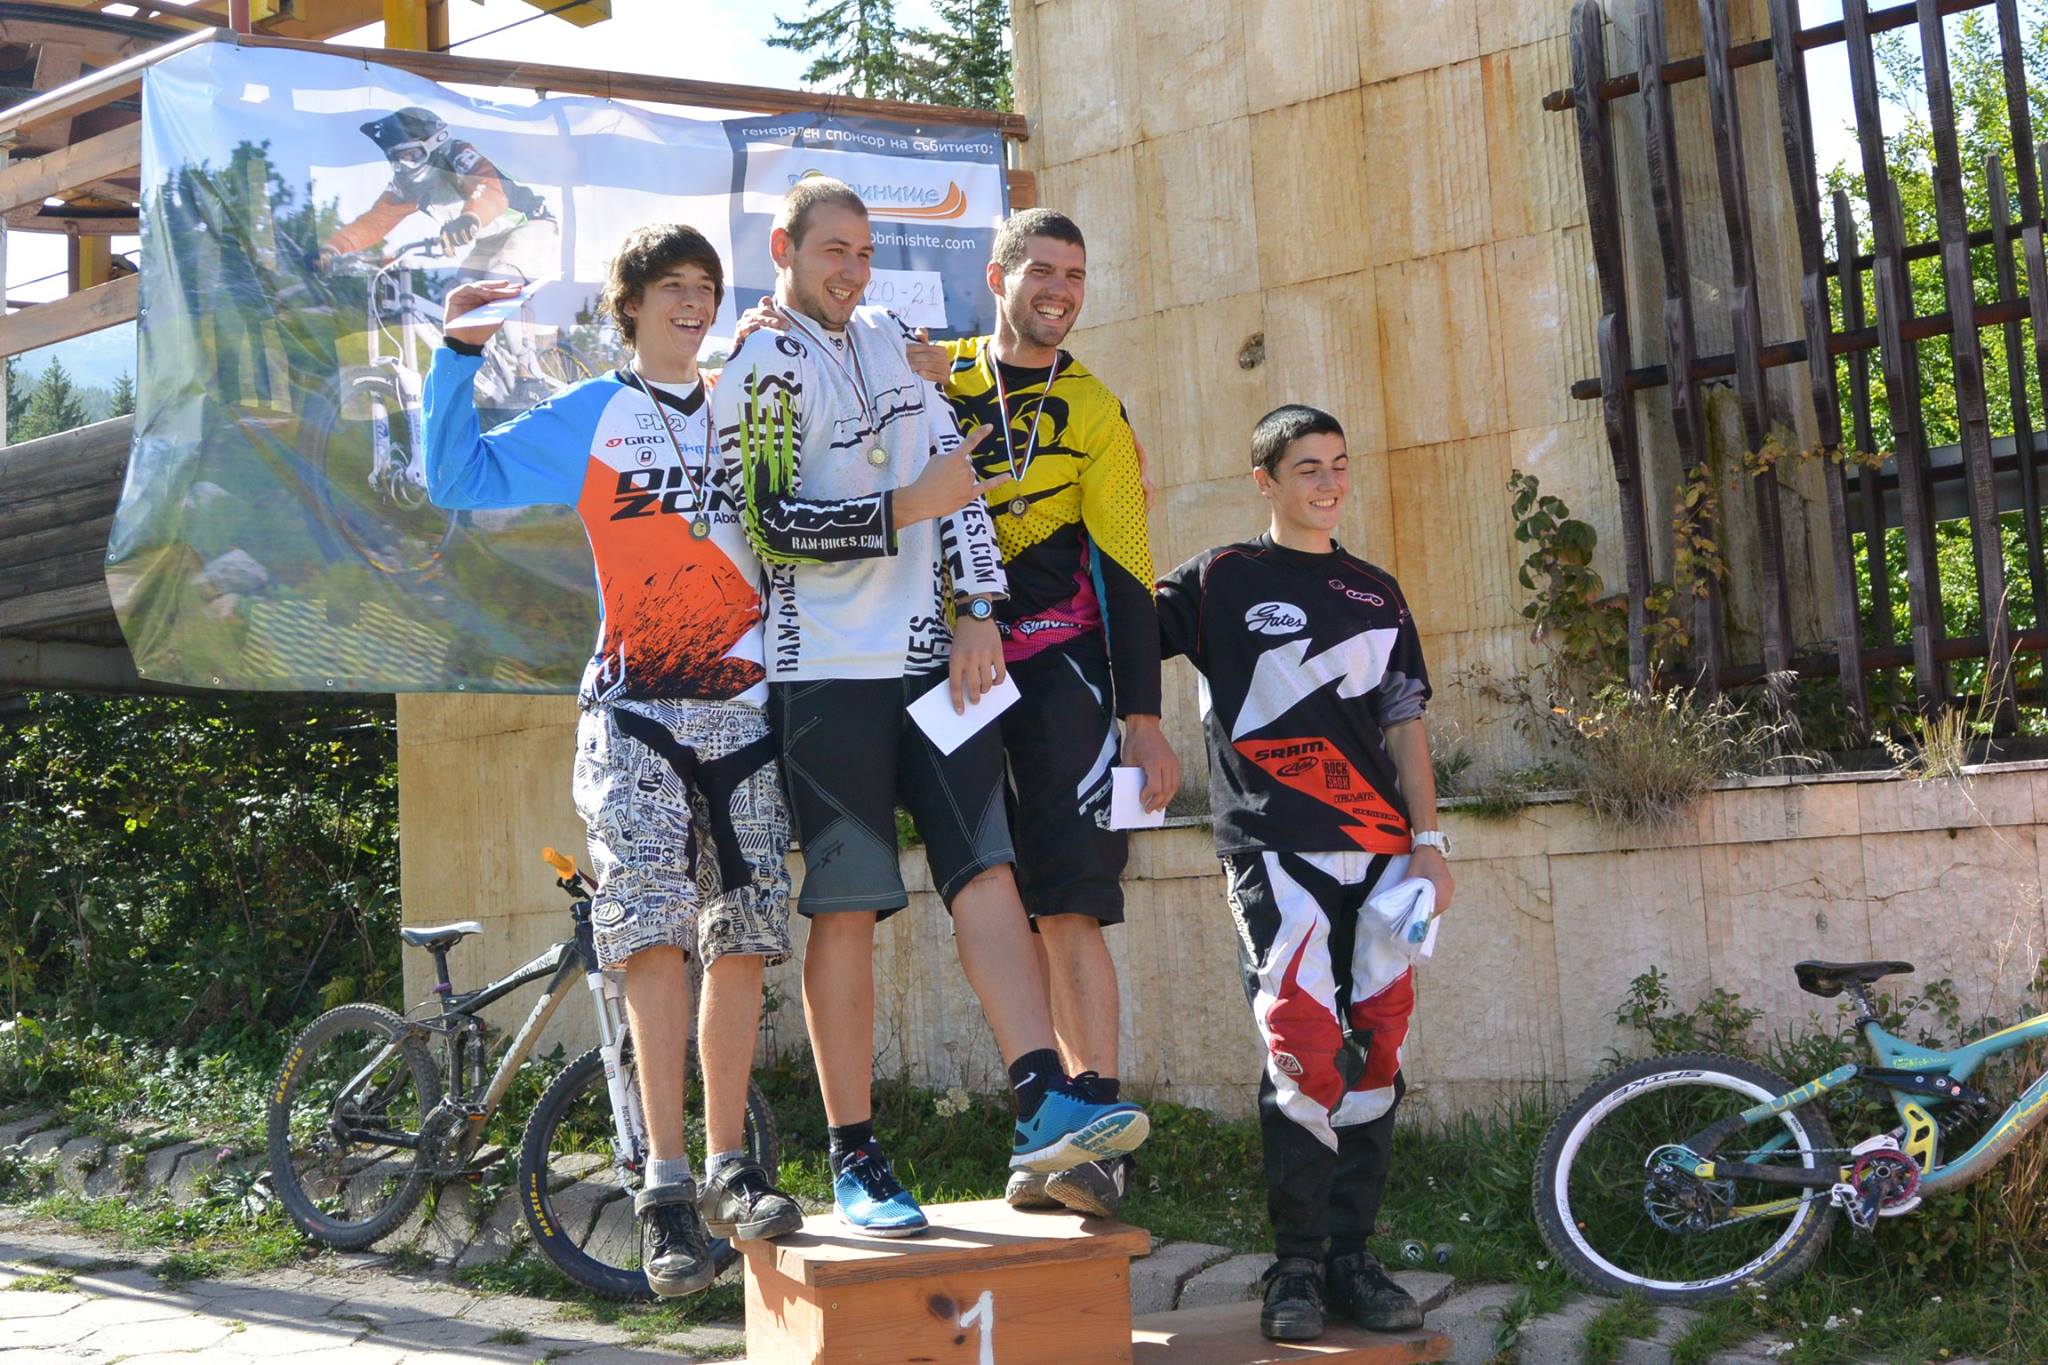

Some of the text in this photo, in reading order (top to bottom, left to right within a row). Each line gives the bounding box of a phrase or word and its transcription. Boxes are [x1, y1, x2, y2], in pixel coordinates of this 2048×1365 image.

[826, 129, 886, 149] спонсор
[890, 139, 908, 150] на
[624, 436, 666, 446] GIRO
[791, 534, 883, 550] RAM-BIKES.COM
[1249, 604, 1305, 632] Gates
[274, 1047, 305, 1105] MAXXIS
[529, 1190, 555, 1237] MAXXIS
[957, 1290, 995, 1365] 1
